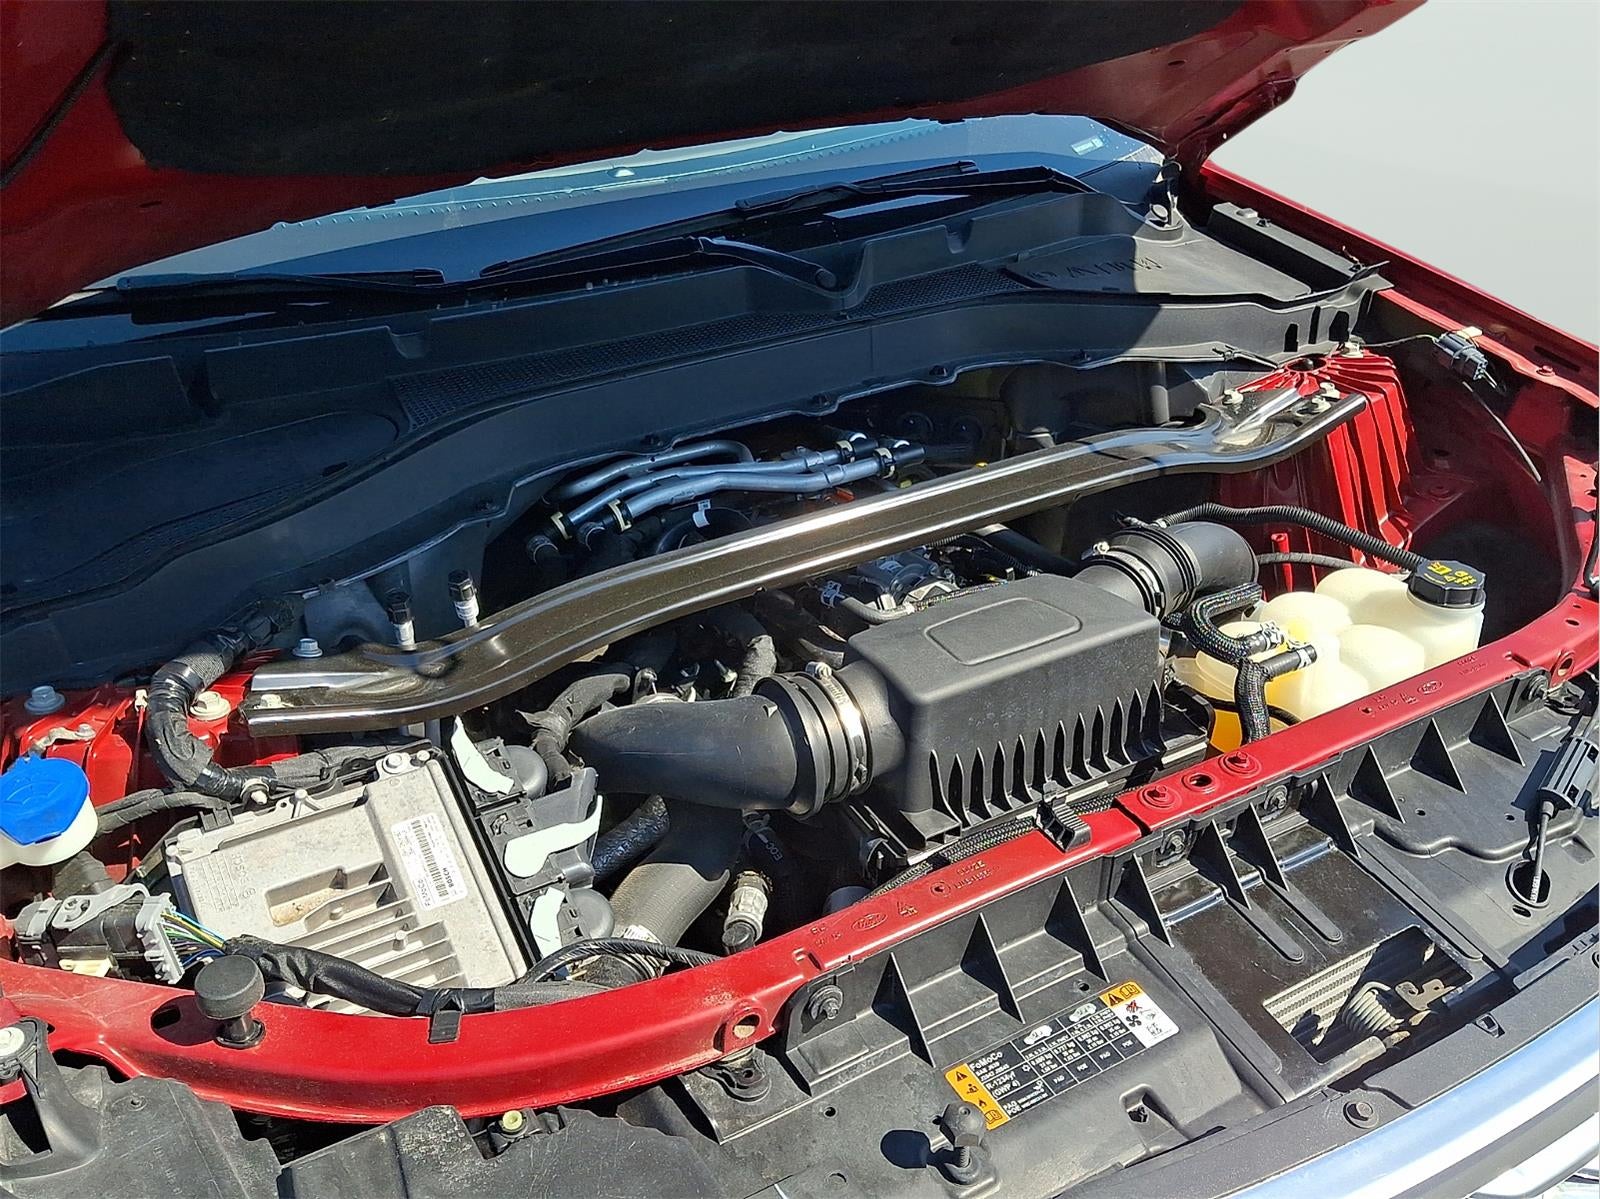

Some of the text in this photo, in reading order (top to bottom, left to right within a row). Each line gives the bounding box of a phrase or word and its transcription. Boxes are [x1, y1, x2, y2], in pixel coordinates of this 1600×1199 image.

[441, 867, 455, 888] BOSCH
[970, 1051, 1003, 1071] FoMoCo
[985, 1070, 1016, 1090] R-1234yf
